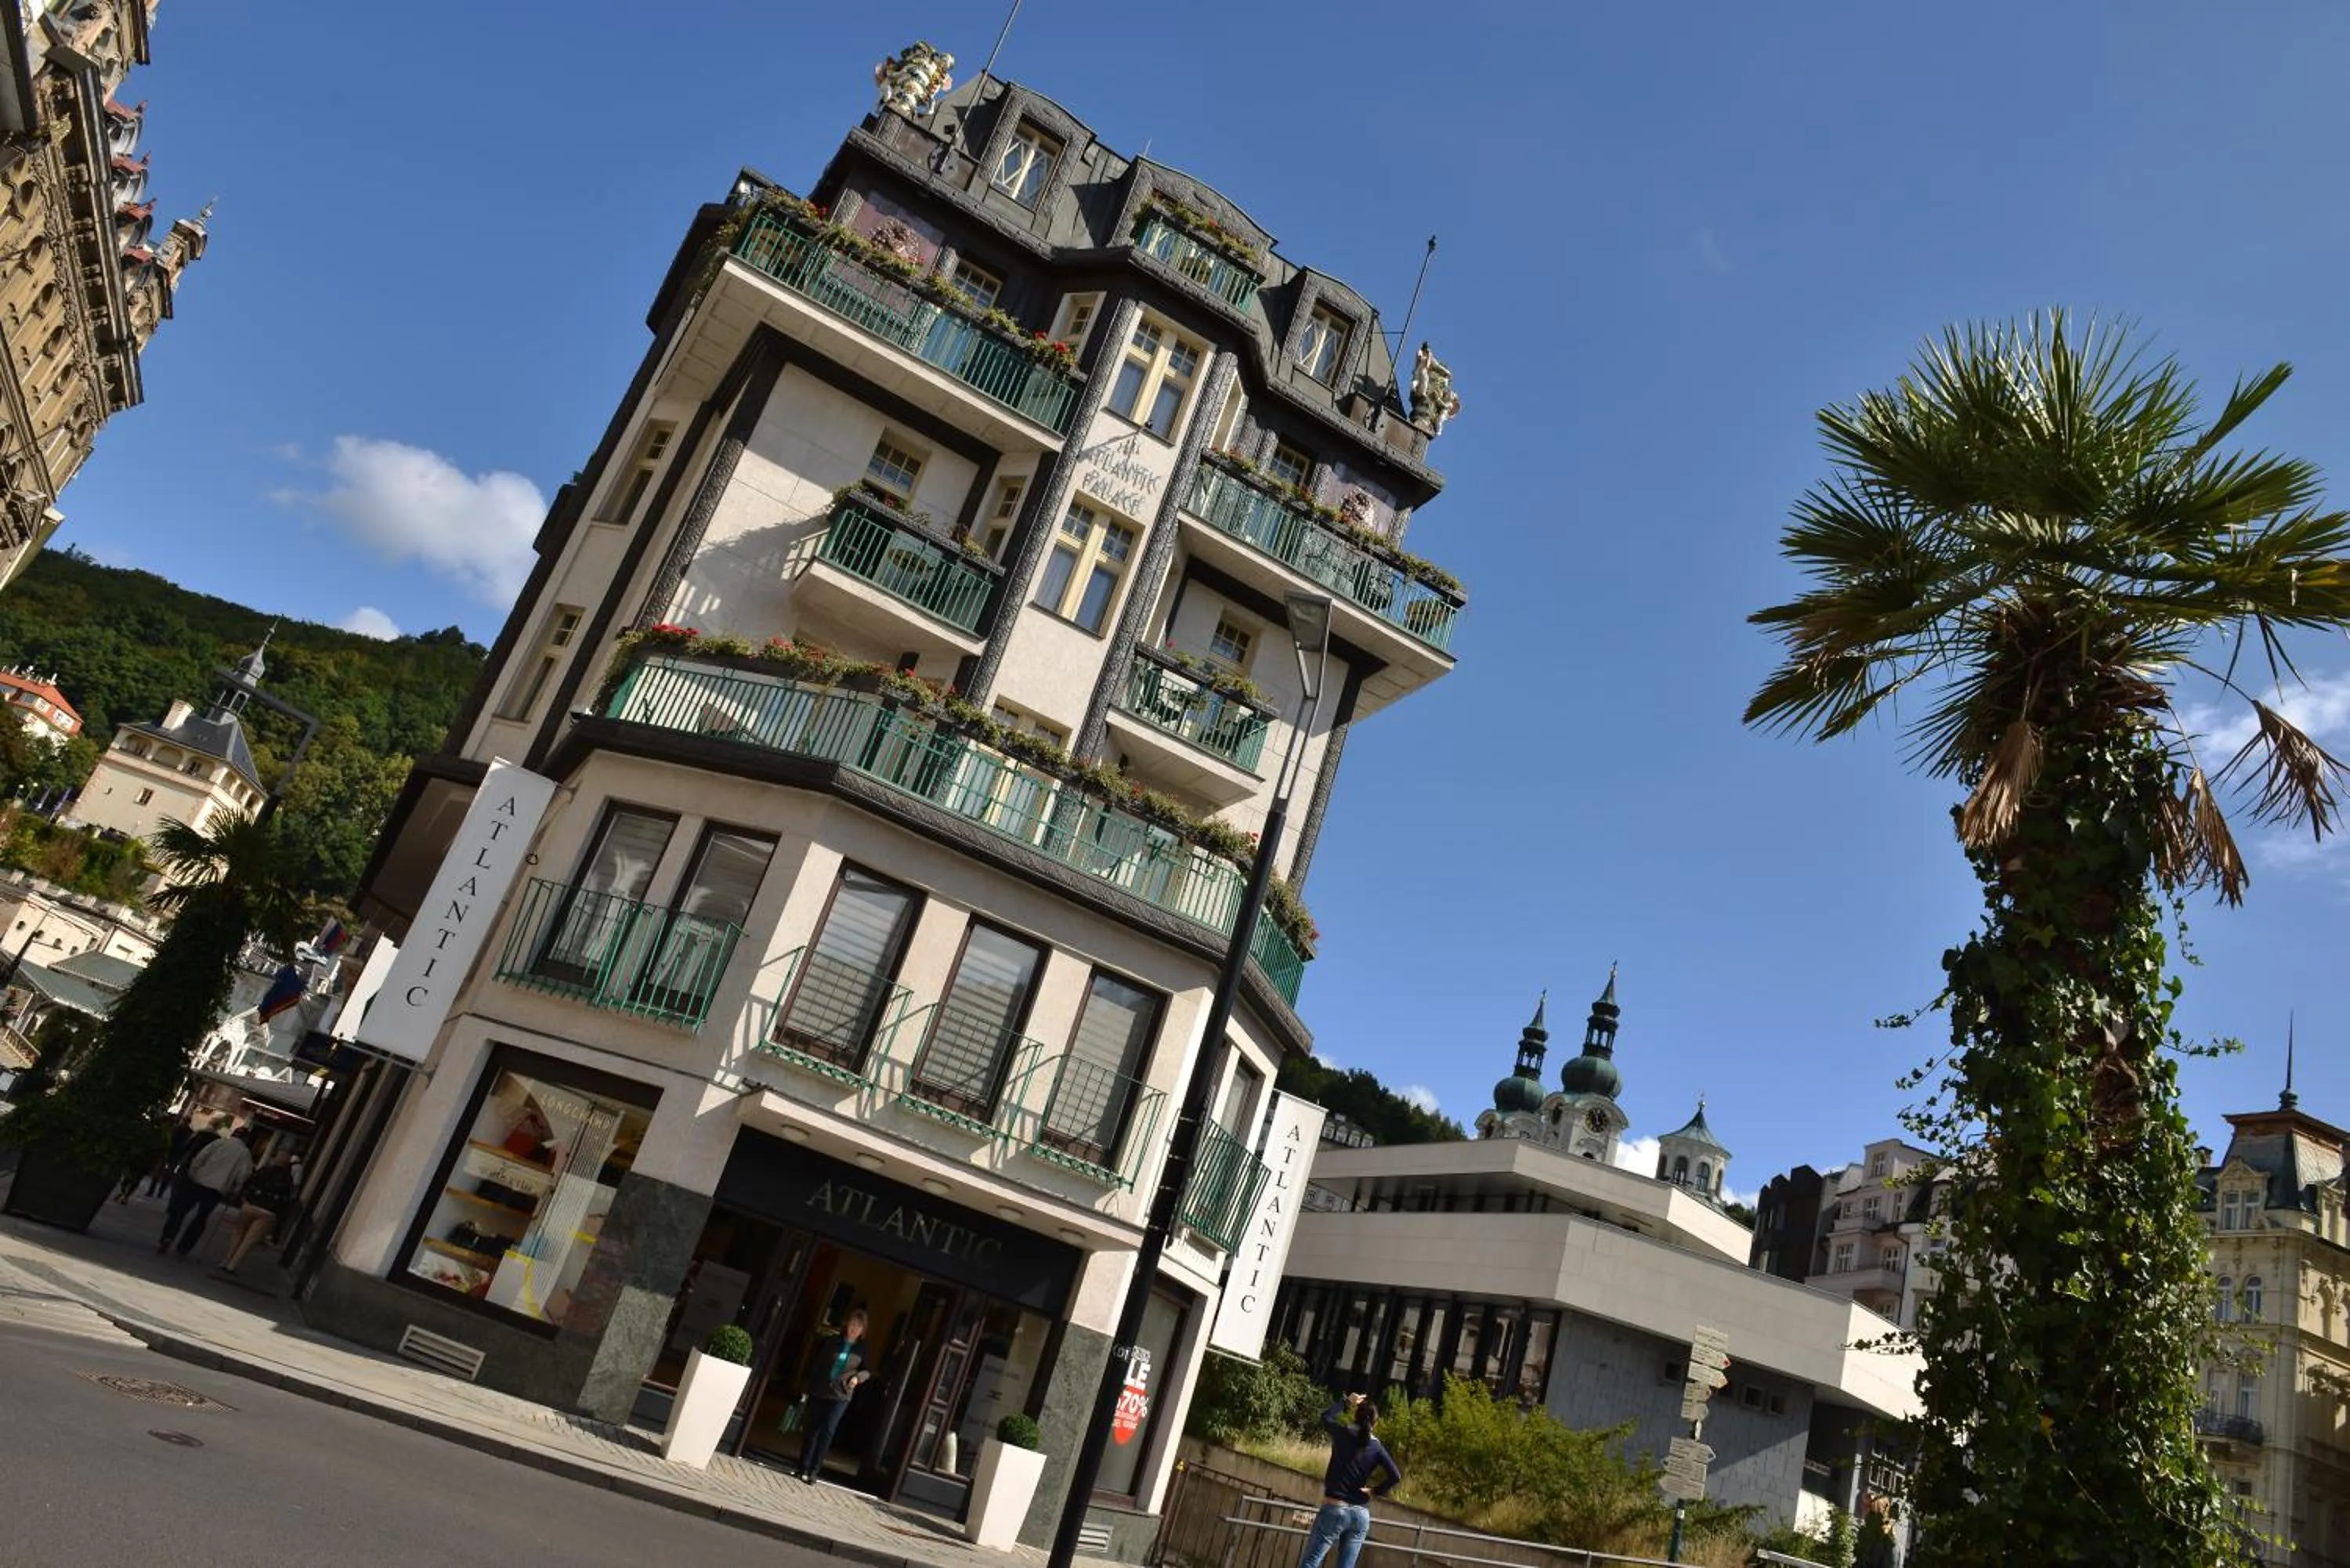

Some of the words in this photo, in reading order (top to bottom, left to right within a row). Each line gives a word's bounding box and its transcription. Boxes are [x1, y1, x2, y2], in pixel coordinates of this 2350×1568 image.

[1082, 469, 1145, 517] PALACE
[407, 796, 516, 1007] ATLANTIC
[805, 1178, 1003, 1266] ATLANTIC
[1240, 1123, 1300, 1313] ATLANTIC
[1123, 1358, 1151, 1390] LE
